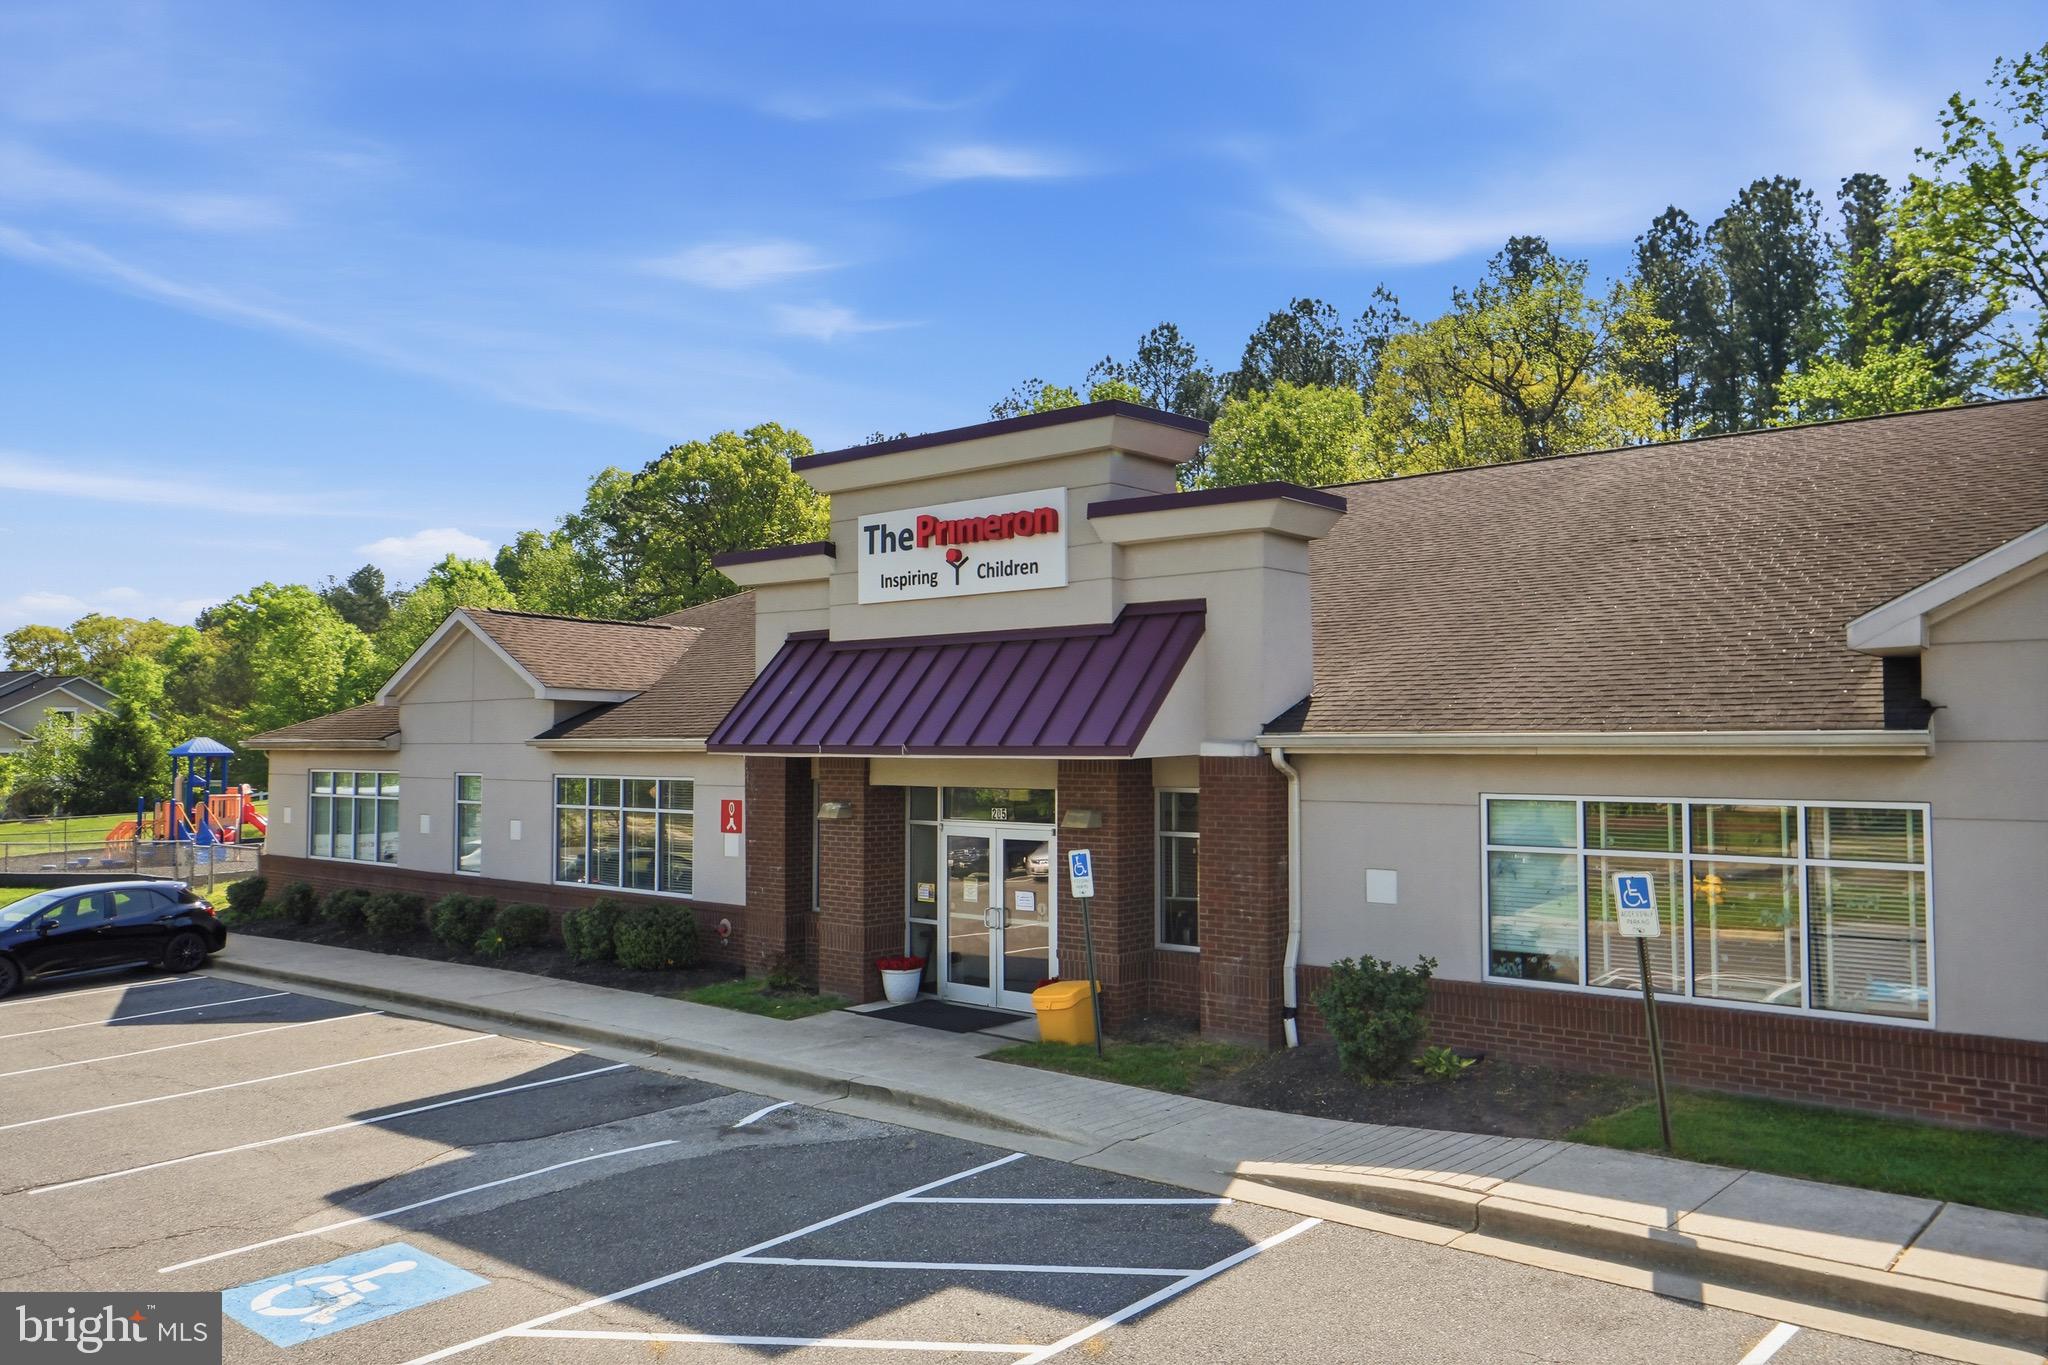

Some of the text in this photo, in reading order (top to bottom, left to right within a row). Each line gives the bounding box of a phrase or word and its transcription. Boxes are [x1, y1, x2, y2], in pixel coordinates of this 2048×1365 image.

[864, 507, 1058, 555] The Primeron
[880, 560, 1039, 591] Inspiring Children
[991, 808, 1006, 819] 205
